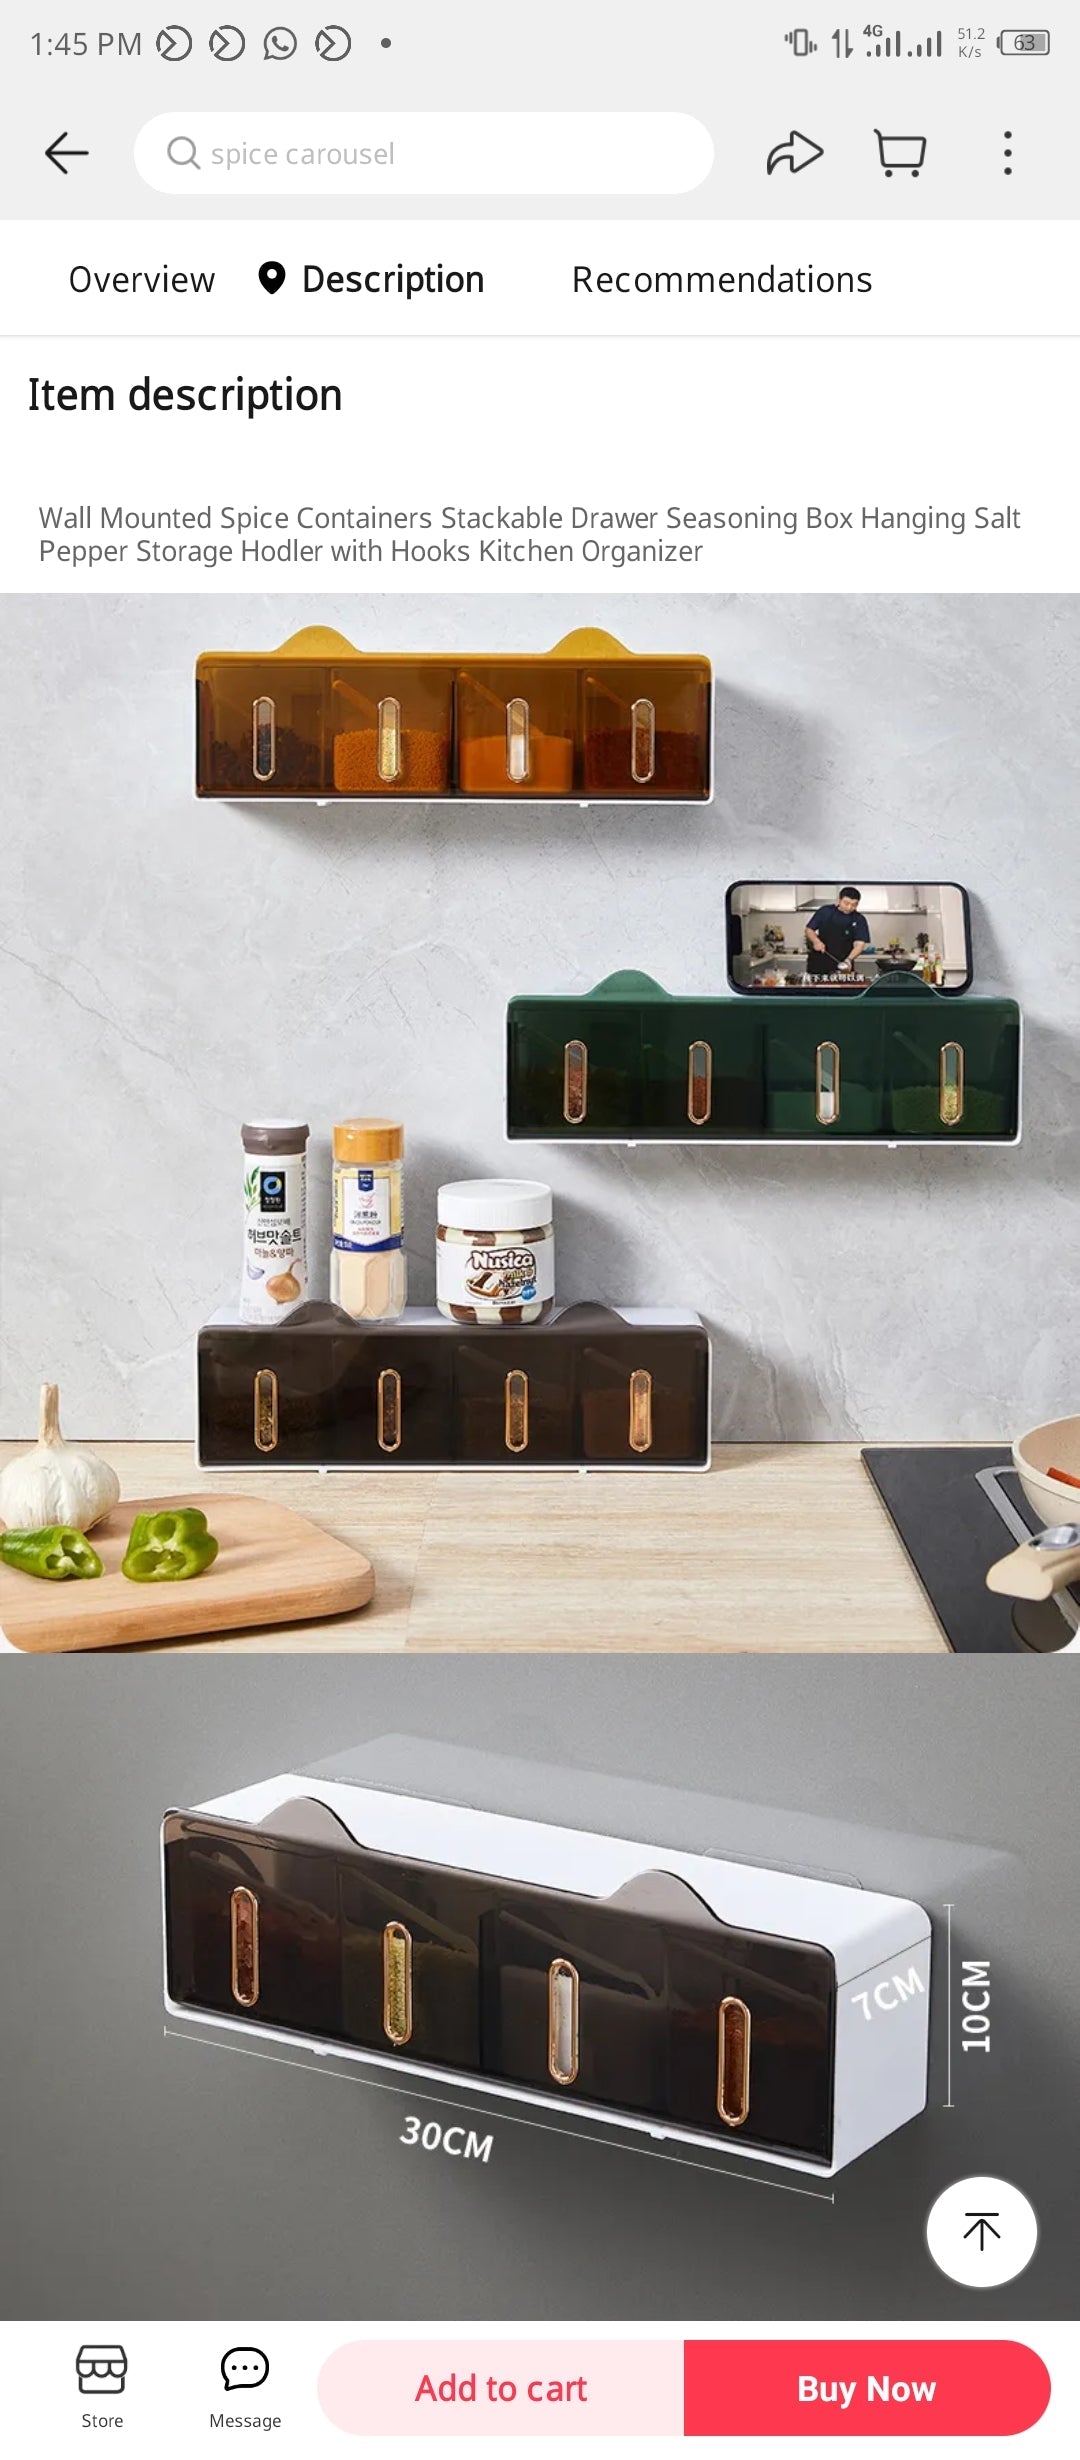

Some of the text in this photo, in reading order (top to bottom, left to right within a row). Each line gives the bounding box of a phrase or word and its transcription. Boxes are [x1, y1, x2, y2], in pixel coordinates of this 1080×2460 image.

[31, 32, 141, 57] 1:45 PM
[863, 24, 883, 38] 4G
[957, 27, 986, 40] 51.2
[1013, 34, 1035, 51] 63
[958, 45, 982, 59] K/s
[211, 141, 395, 171] spice carousel
[69, 263, 216, 294] Overview
[303, 262, 484, 301] Description
[573, 263, 873, 294] Recommendations
[29, 375, 342, 420] Item description
[39, 506, 1021, 535] Wall Mounted Spice Containers Stackable Drawer Seasoning Box Hanging Salt
[40, 538, 704, 569] Pepper Storage Hodler with Hooks Kitchen Organizer
[471, 1250, 534, 1270] Nusica
[415, 2372, 588, 2403] Add to cart
[797, 2374, 938, 2410] Buy Now
[81, 2413, 124, 2428] Store
[209, 2413, 282, 2432] Message
